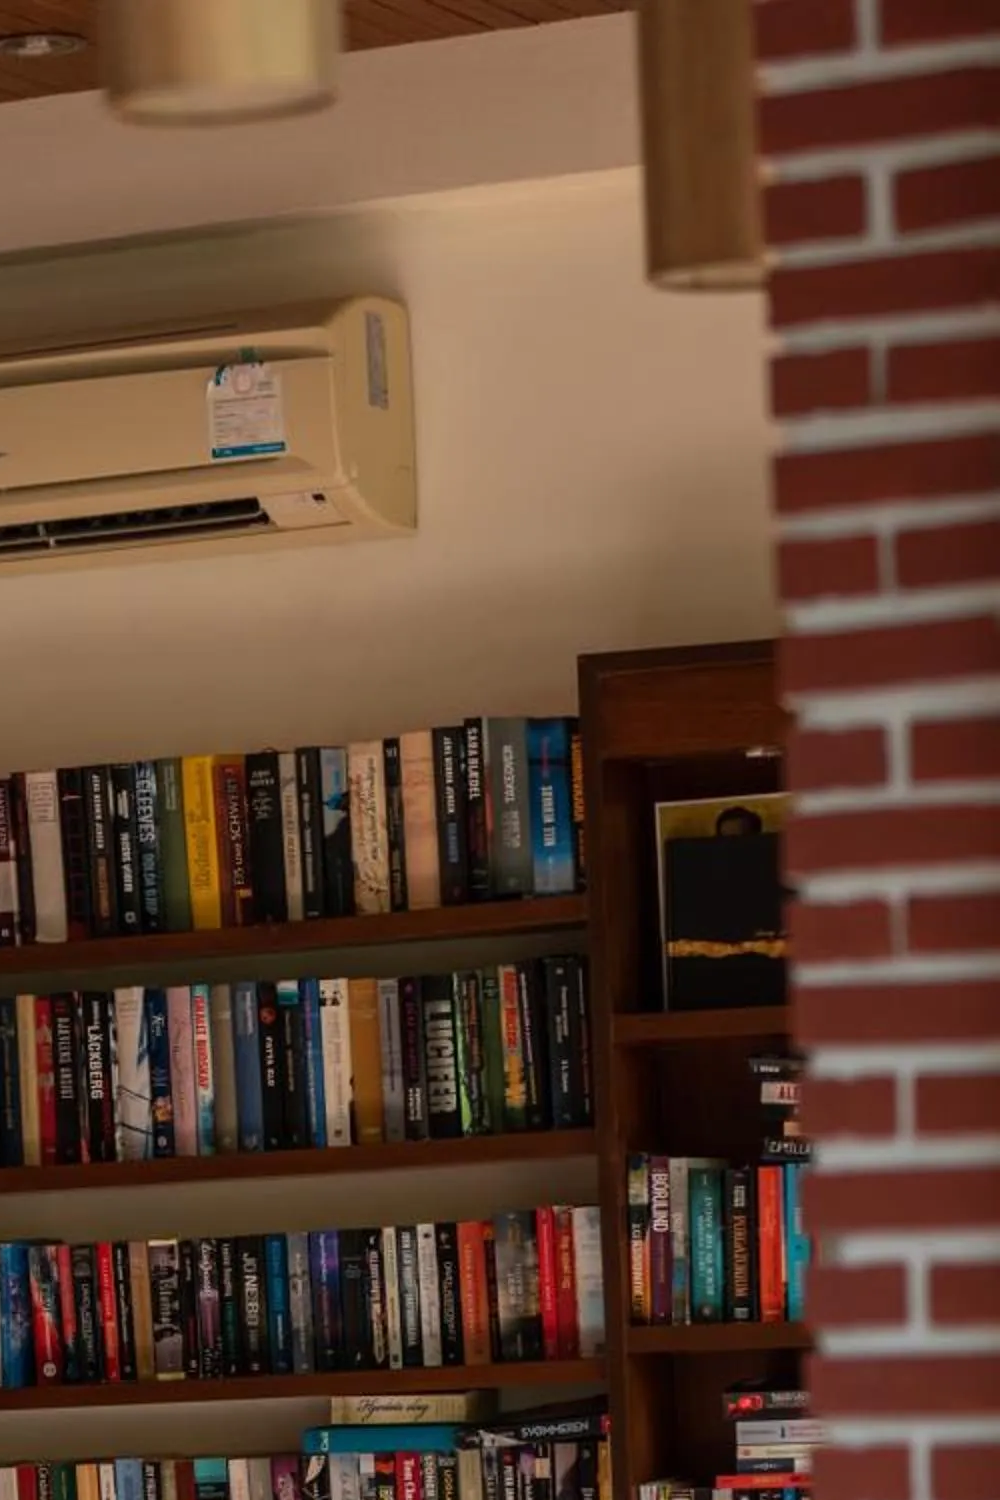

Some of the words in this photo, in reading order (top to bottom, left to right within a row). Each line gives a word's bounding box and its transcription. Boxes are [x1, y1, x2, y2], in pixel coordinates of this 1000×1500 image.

[136, 779, 156, 843] CLEEVES
[86, 1026, 104, 1100] LÄCKBERG
[424, 999, 458, 1114] LUCIFER
[403, 1458, 416, 1481] Tom
